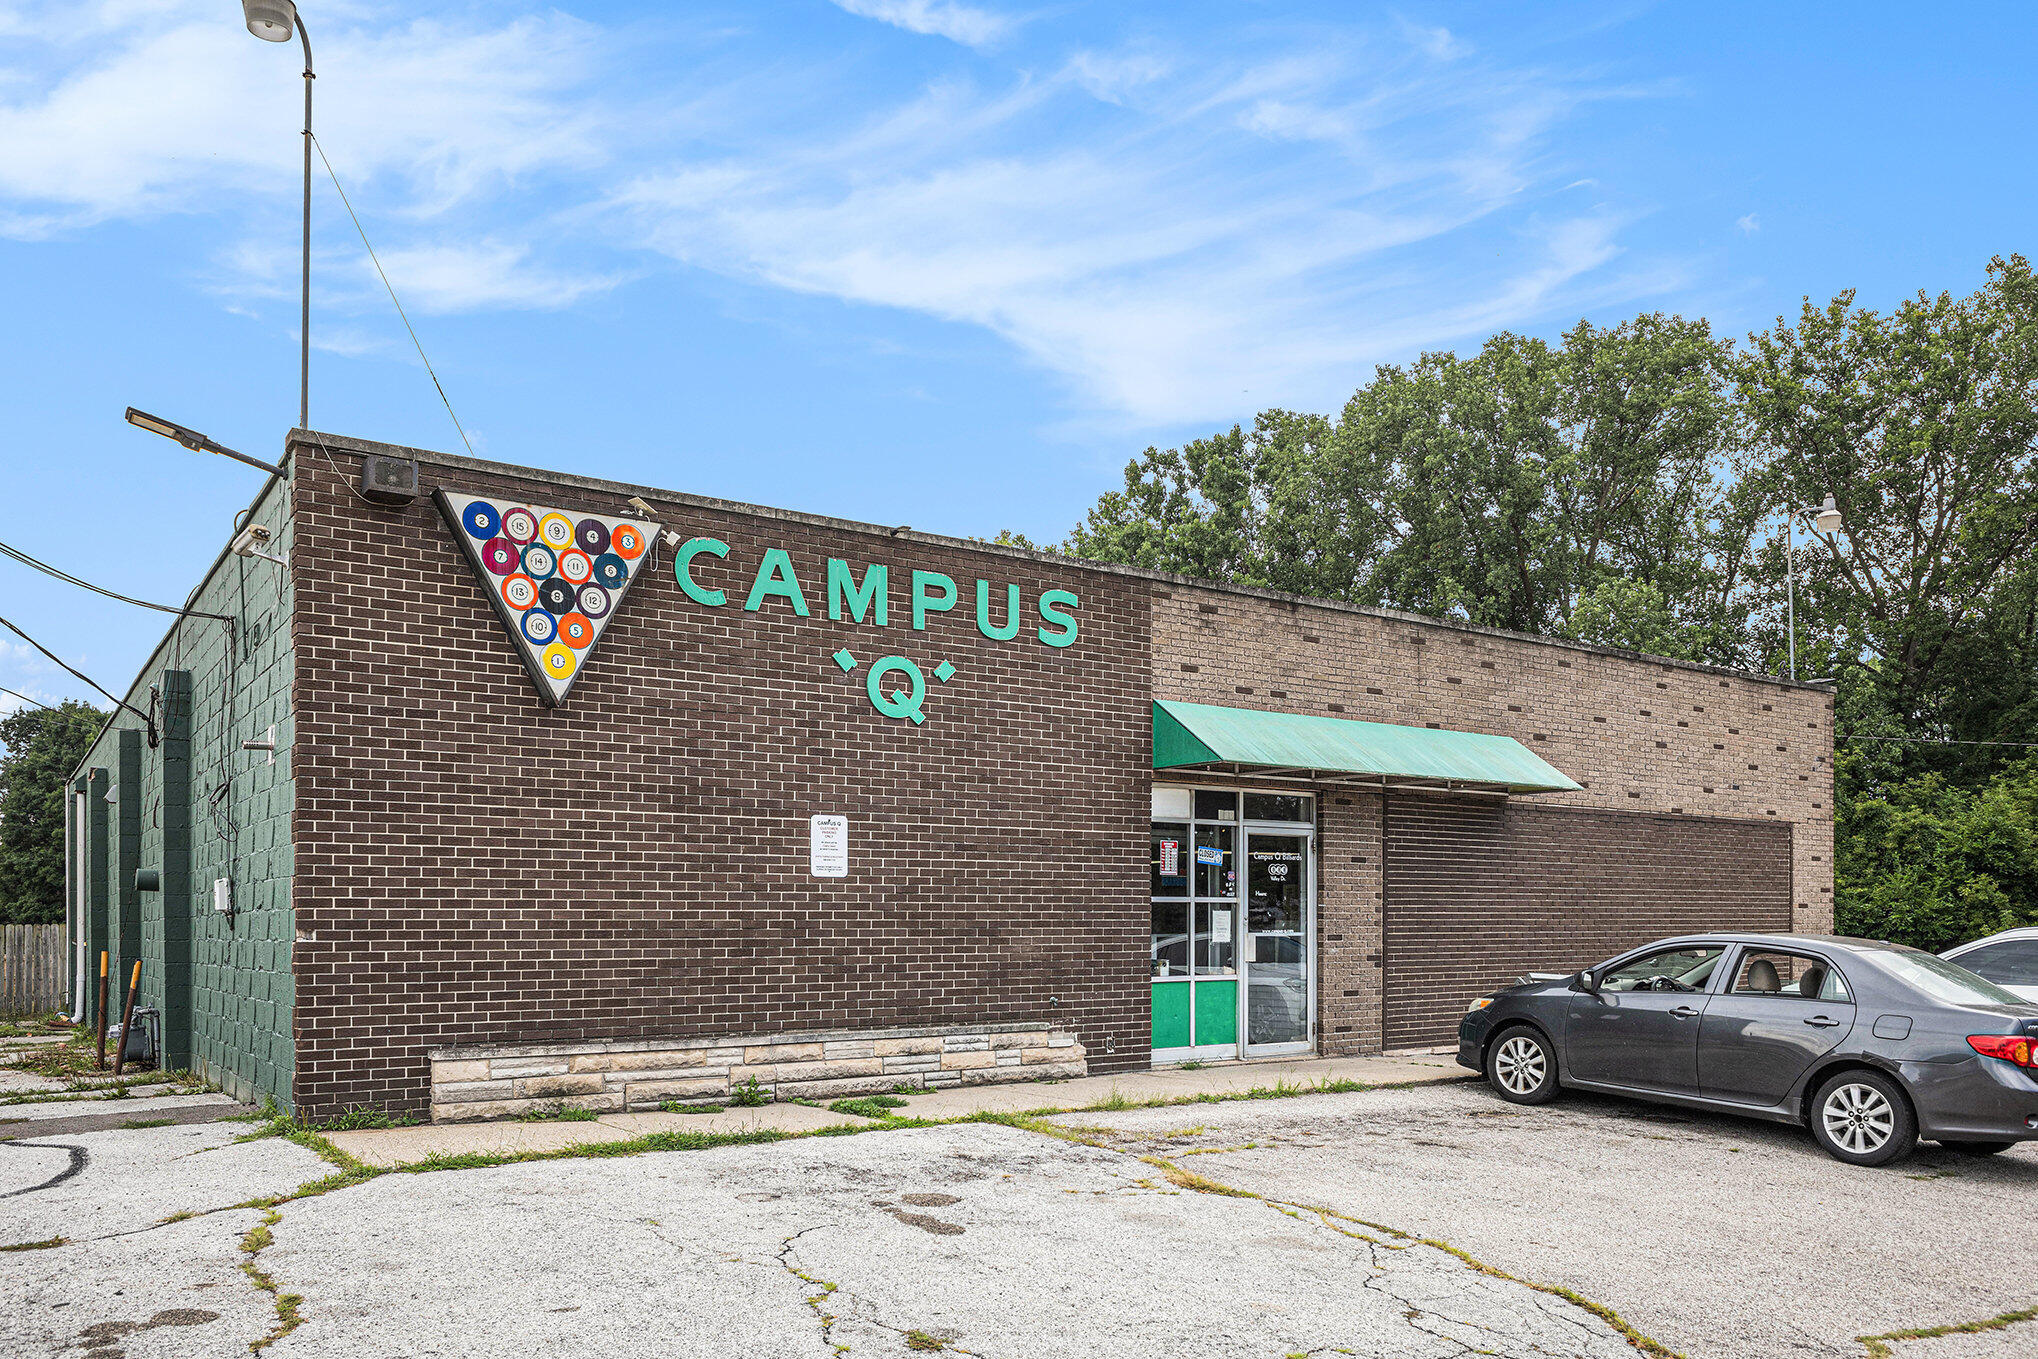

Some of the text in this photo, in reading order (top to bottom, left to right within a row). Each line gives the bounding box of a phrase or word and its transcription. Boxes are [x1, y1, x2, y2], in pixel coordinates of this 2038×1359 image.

[515, 522, 525, 530] 15
[534, 557, 543, 565] 14
[515, 587, 525, 596] 13
[588, 596, 598, 605] 12
[674, 537, 1079, 648] CAMPUS
[535, 622, 544, 631] 10
[867, 656, 927, 725] Q
[1198, 849, 1214, 858] CLOSED
[1253, 851, 1274, 861] Campus
